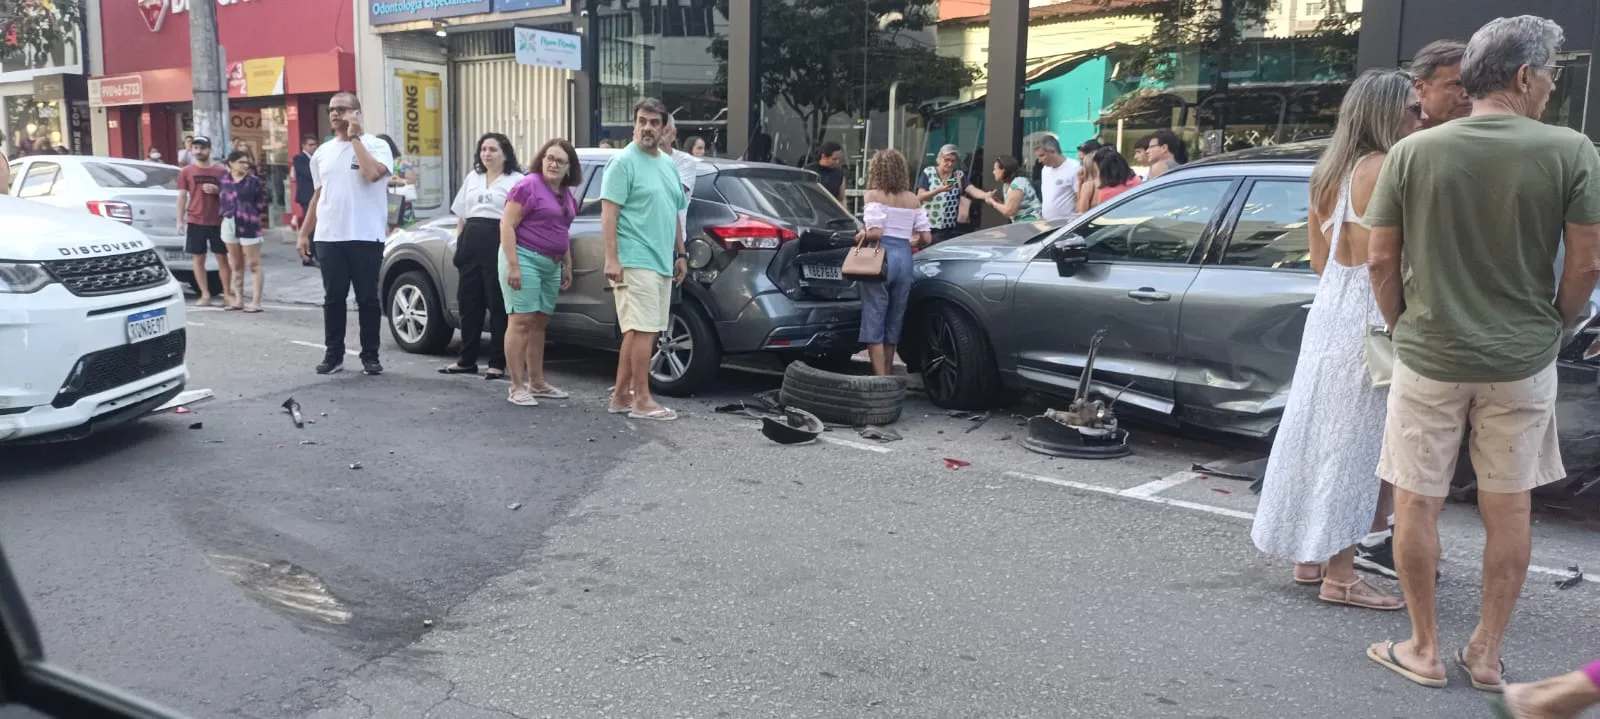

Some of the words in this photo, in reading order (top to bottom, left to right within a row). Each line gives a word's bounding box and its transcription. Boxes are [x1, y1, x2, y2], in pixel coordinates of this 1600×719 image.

[372, 0, 422, 15] Odontologia
[426, 0, 483, 10] Especia
[406, 84, 420, 154] STRONG
[58, 240, 144, 256] DISCOVERY
